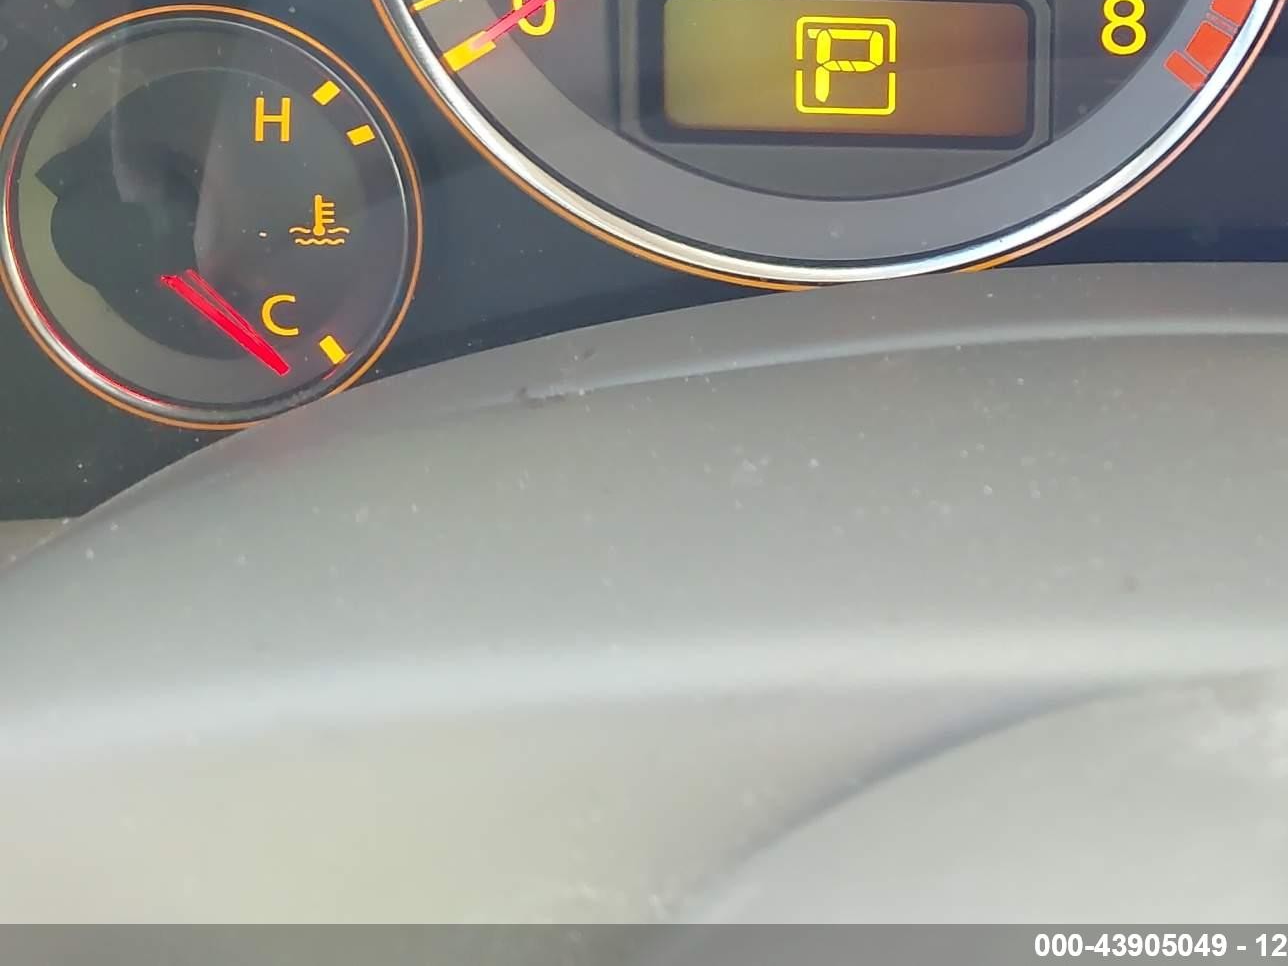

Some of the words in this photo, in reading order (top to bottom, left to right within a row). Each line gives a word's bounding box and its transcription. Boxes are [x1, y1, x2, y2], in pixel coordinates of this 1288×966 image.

[806, 27, 885, 104] P
[254, 96, 291, 142] H
[261, 294, 299, 336] C
